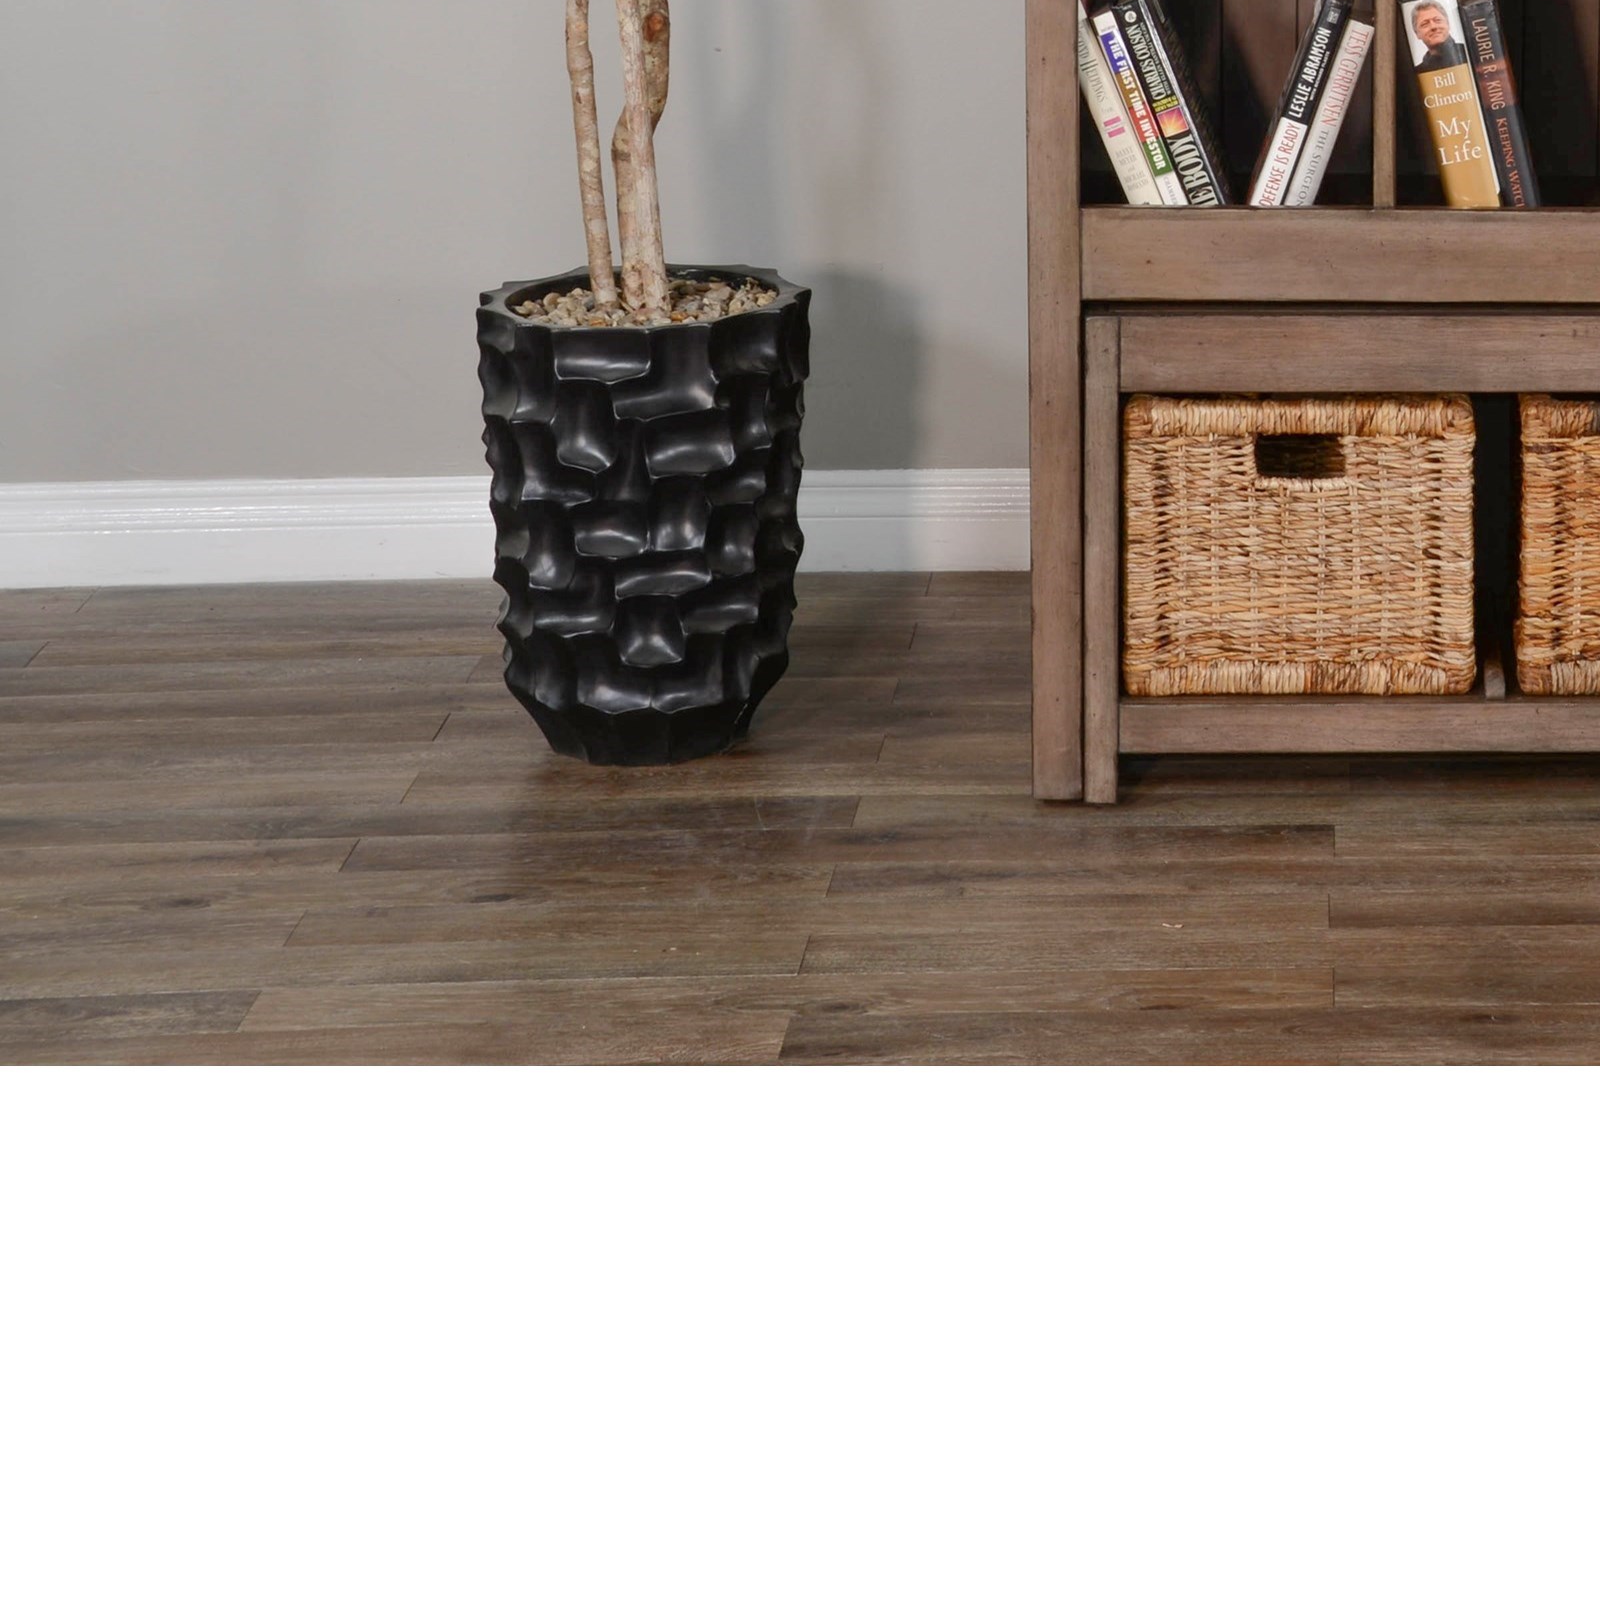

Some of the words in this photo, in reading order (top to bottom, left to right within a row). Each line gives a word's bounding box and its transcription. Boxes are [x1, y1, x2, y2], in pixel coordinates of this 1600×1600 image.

[1125, 24, 1150, 60] COLSON
[1344, 29, 1369, 58] TESS
[1472, 18, 1494, 62] LAURIE
[1140, 58, 1166, 100] CHARLES
[1289, 83, 1311, 118] LESLIE
[1302, 27, 1331, 83] ABRAMSON
[1434, 72, 1456, 89] Bill
[1482, 64, 1497, 77] R.
[1109, 36, 1124, 59] THE
[1117, 60, 1136, 89] FIRST
[1129, 90, 1146, 118] TIME
[1139, 118, 1166, 169] INVESTOR
[1321, 58, 1359, 128] GERRITSEN
[1424, 90, 1473, 109] Clinton
[1486, 80, 1505, 110] KING
[1277, 122, 1301, 154] READY
[1316, 131, 1329, 150] THE
[1437, 116, 1471, 140] My
[1496, 117, 1515, 167] KEEPING
[1167, 134, 1210, 190] BODY
[1274, 154, 1289, 165] IS
[1438, 140, 1482, 166] Life
[1258, 166, 1285, 208] DEFENSE
